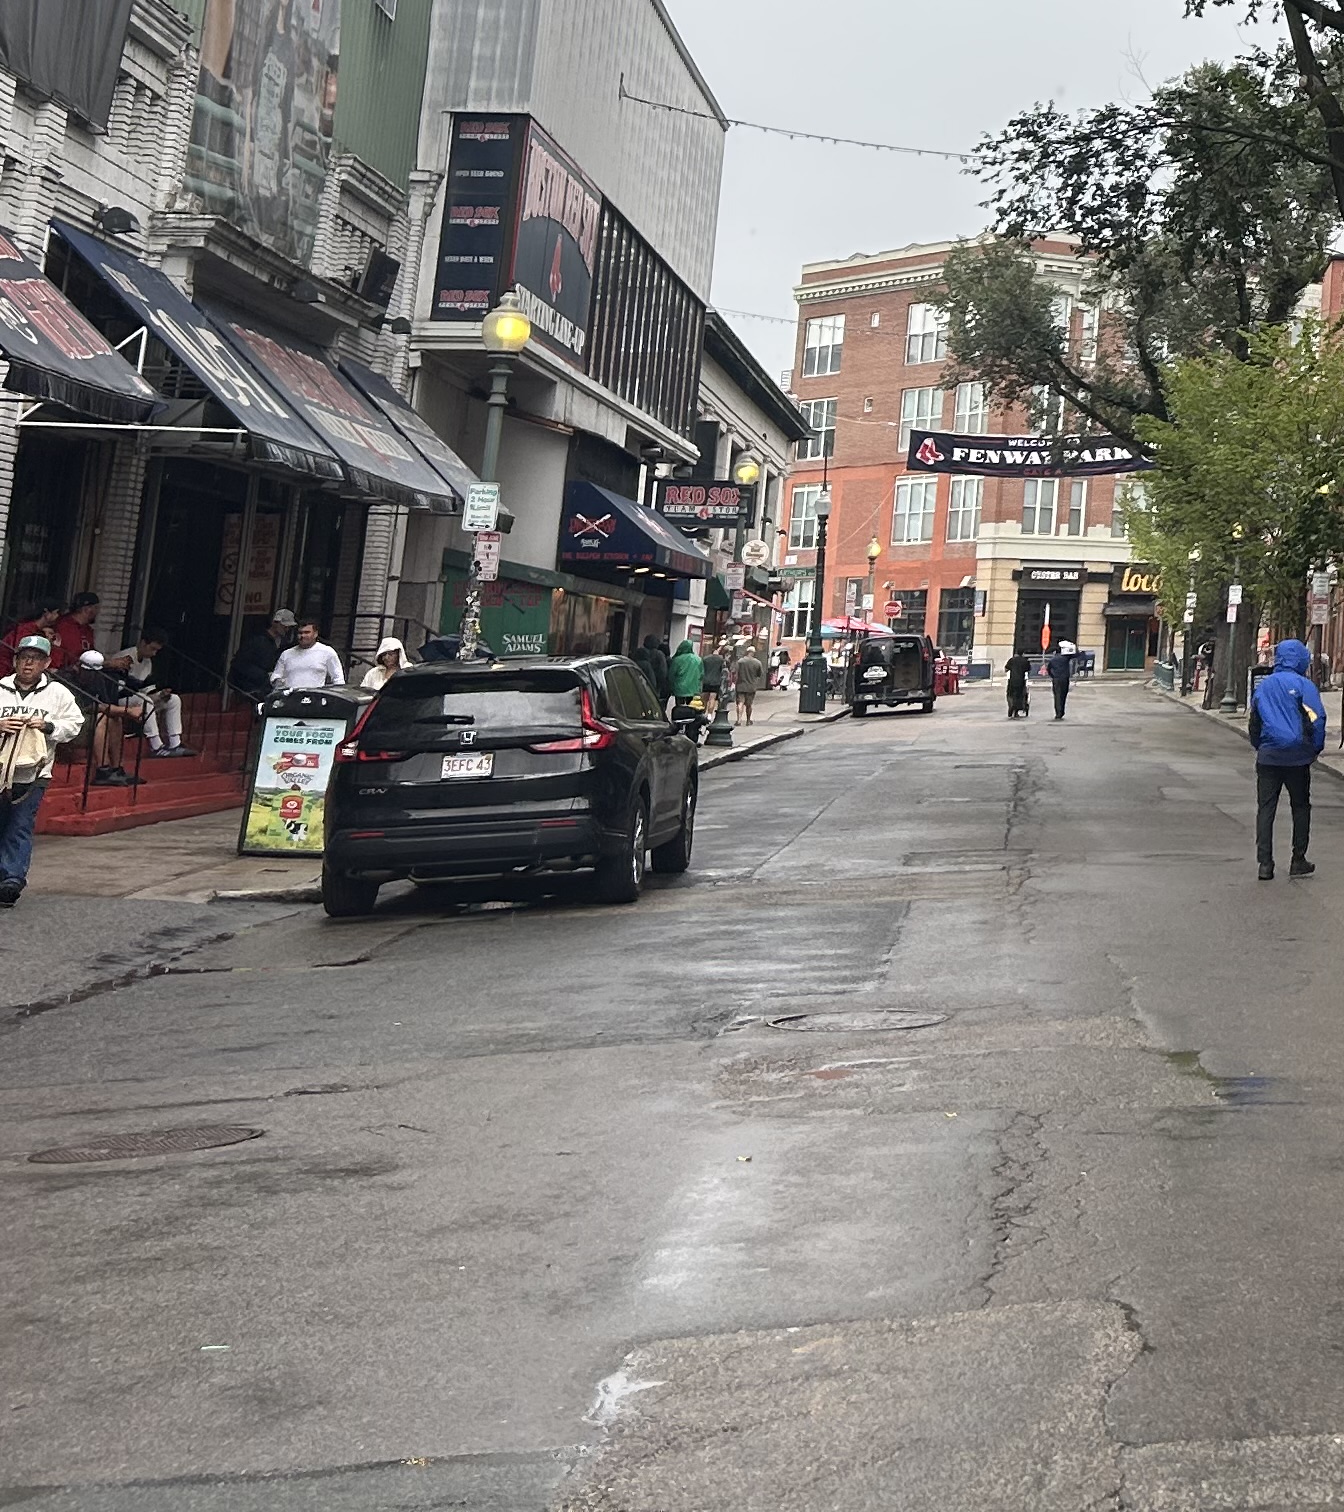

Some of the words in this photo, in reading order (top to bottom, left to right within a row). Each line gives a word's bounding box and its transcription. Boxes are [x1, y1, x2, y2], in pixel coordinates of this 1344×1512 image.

[469, 487, 498, 498] Parking
[665, 485, 706, 505] RED
[707, 486, 741, 506] SOX
[712, 506, 739, 514] STOR
[1030, 570, 1061, 580] OYSTER
[1062, 570, 1079, 580] BAR
[244, 591, 262, 603] NO
[502, 632, 547, 645] SAMUEL
[505, 642, 542, 654] ADAMS
[0, 705, 49, 718] ENWAY
[275, 730, 303, 738] YOUR
[306, 731, 334, 739] FOOD
[273, 737, 304, 745] COMES
[305, 738, 333, 746] FROM
[444, 758, 474, 773] 3EFC
[476, 758, 492, 771] 43
